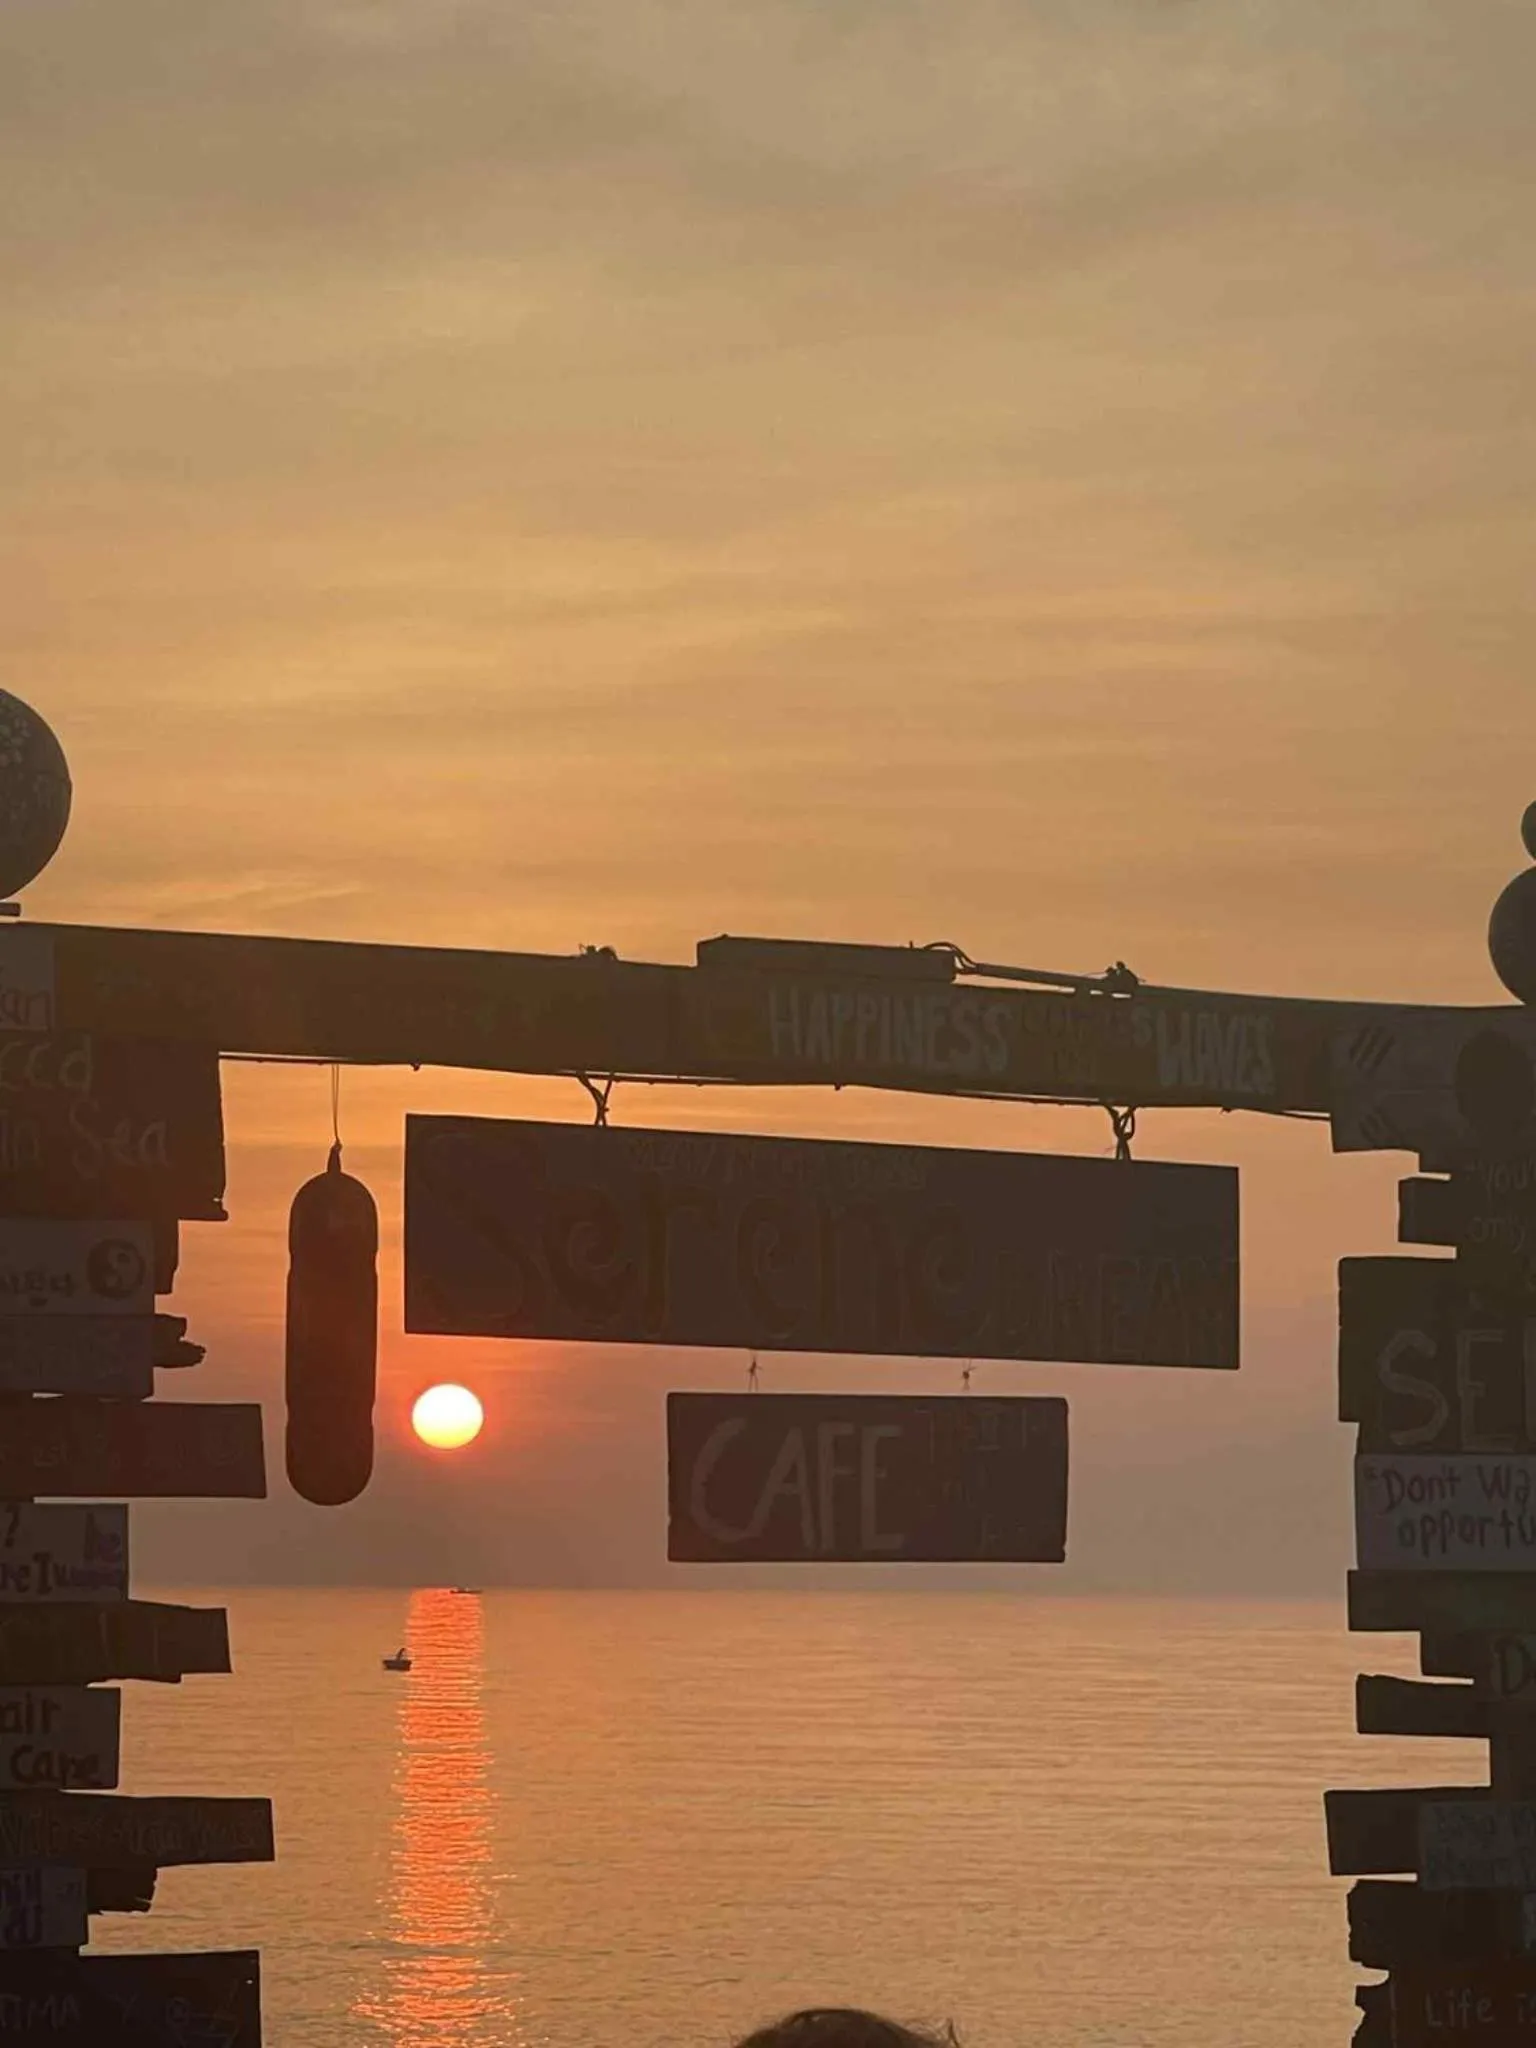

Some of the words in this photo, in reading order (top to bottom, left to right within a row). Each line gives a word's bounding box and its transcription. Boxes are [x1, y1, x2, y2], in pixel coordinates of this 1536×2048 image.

[766, 985, 1015, 1075] HAPPINESS
[1155, 1008, 1276, 1096] WAVES
[67, 1097, 172, 1181] Sea
[690, 1416, 906, 1553] CAFE
[1492, 1635, 1536, 1696] D
[1425, 1987, 1494, 2030] Life
